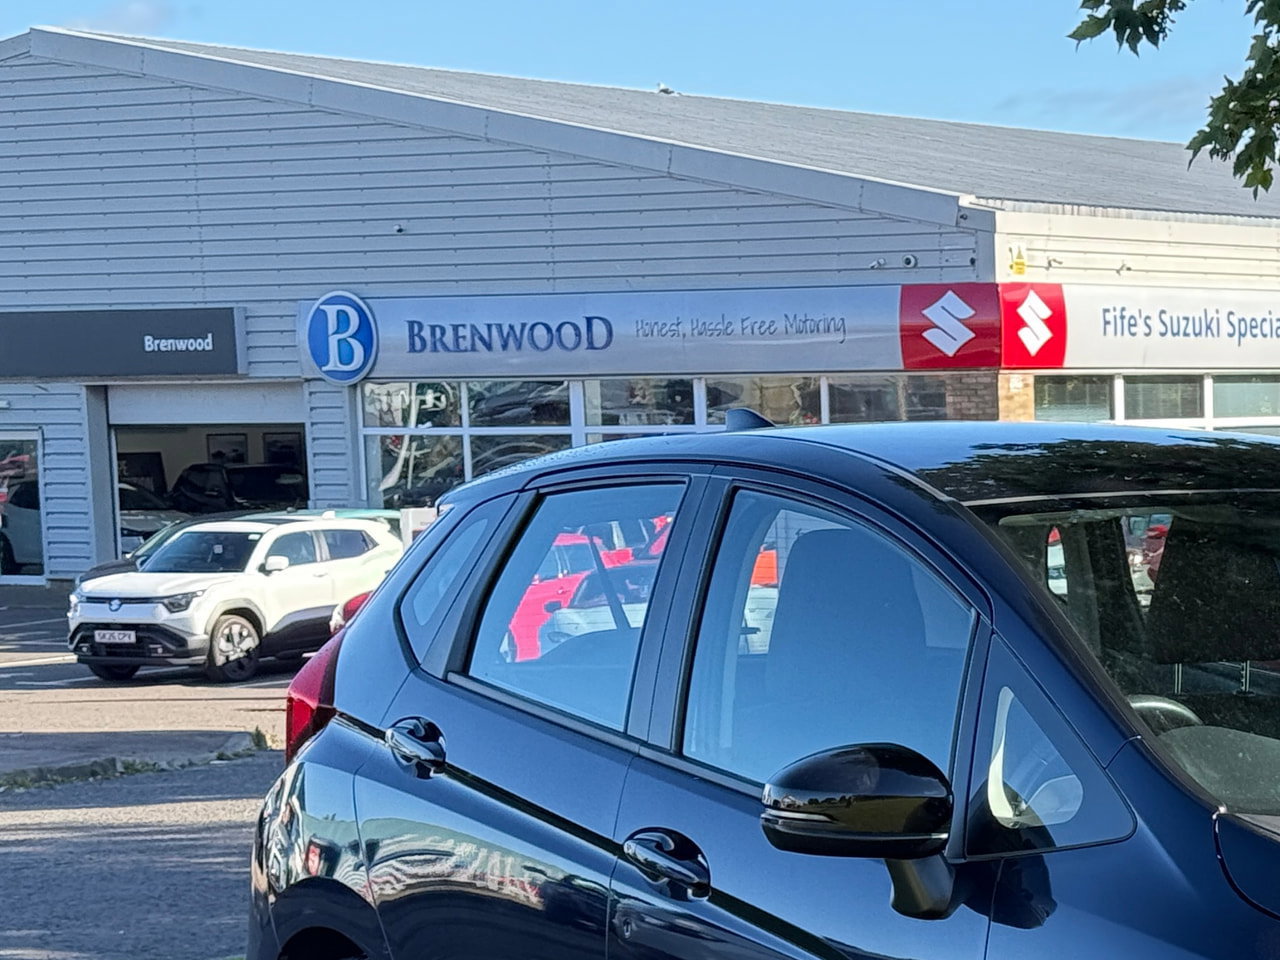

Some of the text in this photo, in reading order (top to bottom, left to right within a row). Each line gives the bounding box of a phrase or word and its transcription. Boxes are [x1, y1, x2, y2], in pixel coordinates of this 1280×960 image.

[405, 316, 614, 353] BRENWOOD
[690, 313, 734, 338] Hassle
[740, 315, 778, 337] Free
[784, 312, 847, 344] Motoring
[1101, 306, 1153, 338] Fife's
[1158, 308, 1220, 338] Suzuki
[144, 333, 213, 351] Brenwood
